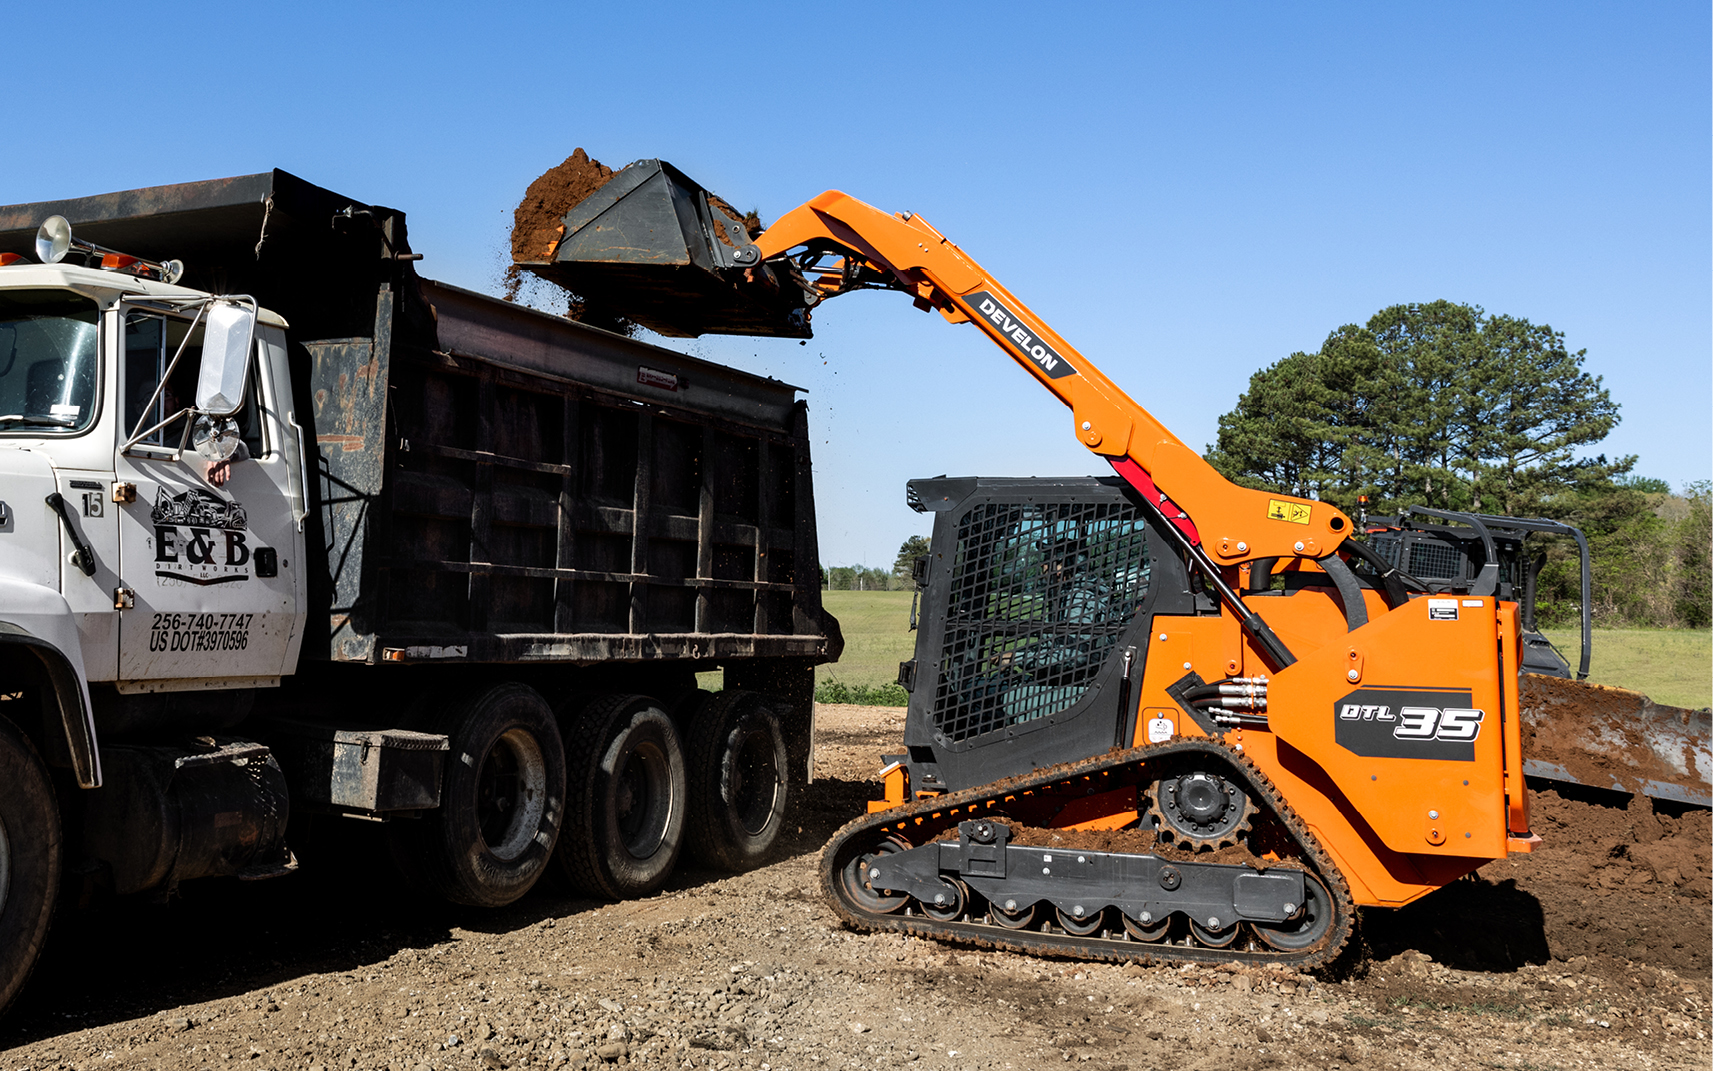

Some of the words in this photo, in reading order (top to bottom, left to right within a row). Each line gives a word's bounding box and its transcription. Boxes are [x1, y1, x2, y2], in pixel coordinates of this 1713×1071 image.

[979, 298, 1058, 371] DEVELON
[82, 492, 104, 518] 15
[153, 525, 178, 562] E
[186, 528, 217, 564] &
[224, 530, 250, 566] B
[151, 613, 254, 630] 256-740-7747
[149, 630, 169, 652] US
[170, 630, 249, 652] DOT#3970596
[1340, 704, 1397, 722] DTL
[1392, 706, 1486, 743] 35
